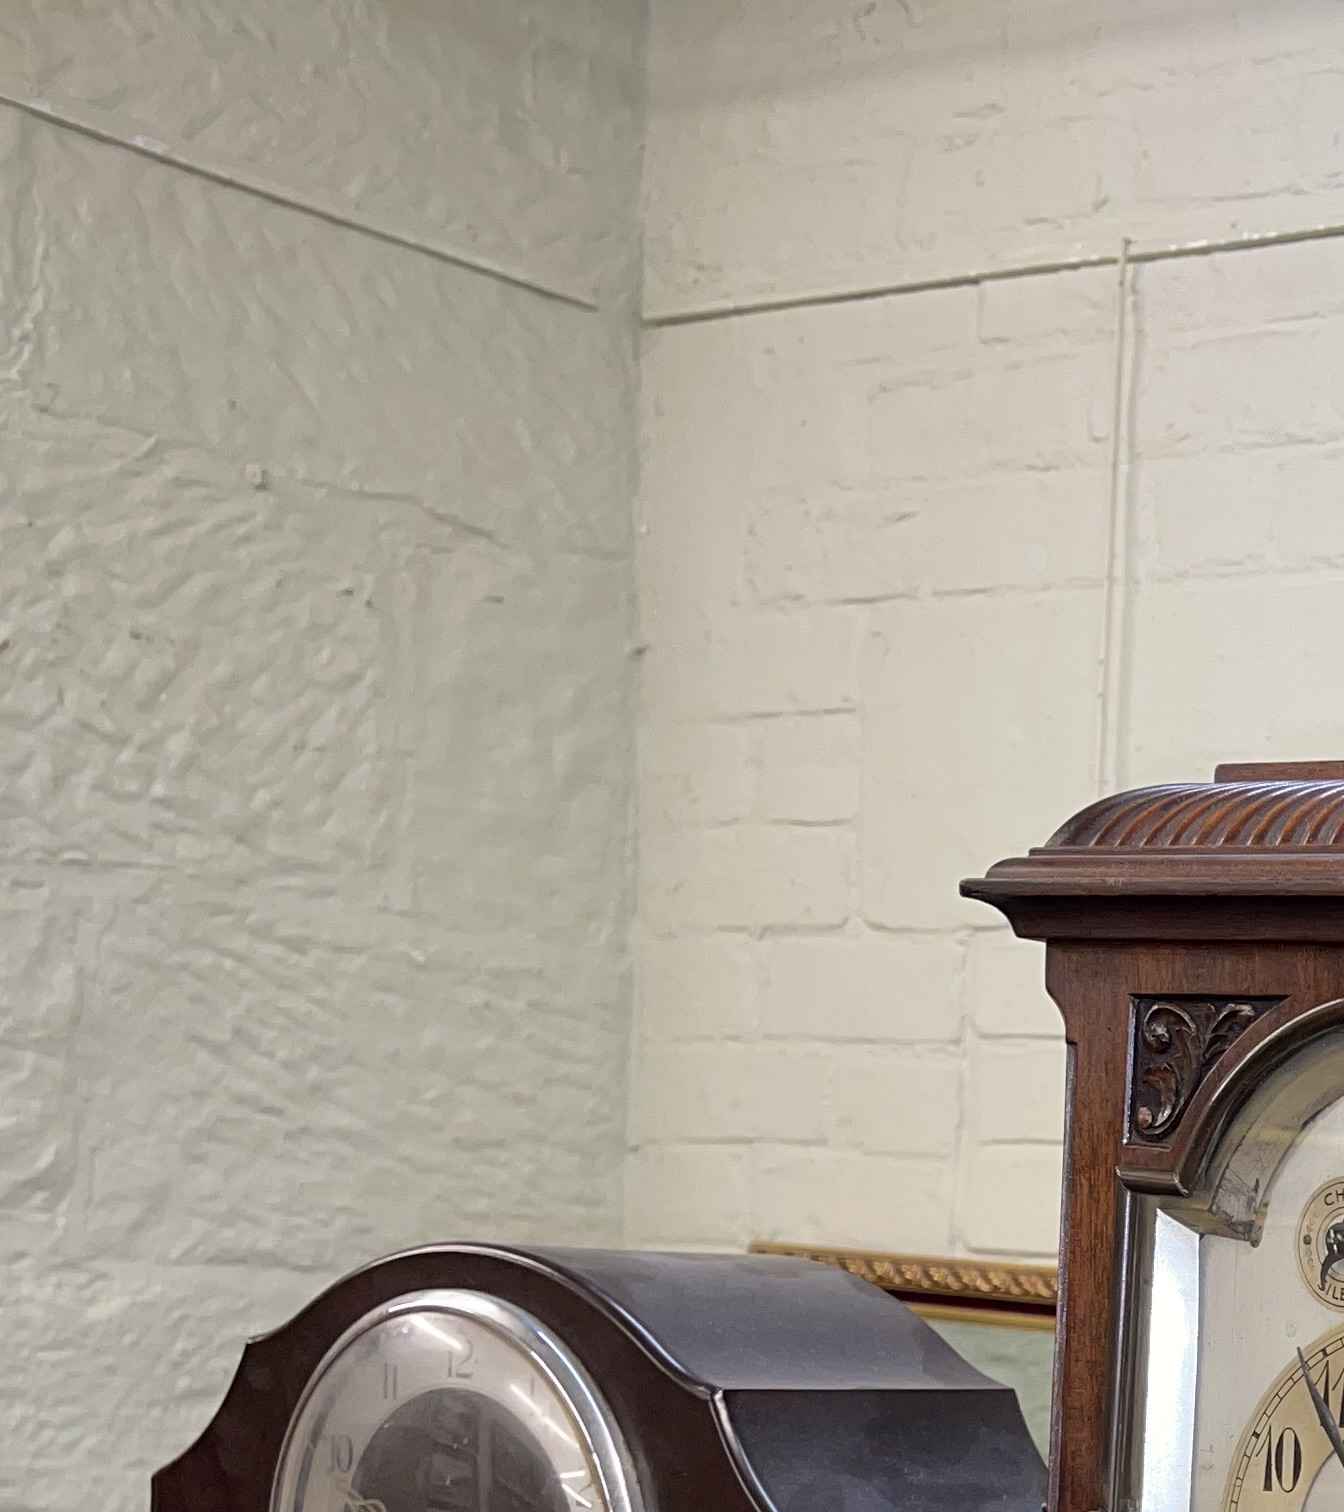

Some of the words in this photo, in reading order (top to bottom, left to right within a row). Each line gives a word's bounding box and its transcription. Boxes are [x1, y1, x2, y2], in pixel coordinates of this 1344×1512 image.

[448, 1338, 474, 1378] 12
[328, 1434, 354, 1473] 10
[1256, 1426, 1303, 1493] 10
